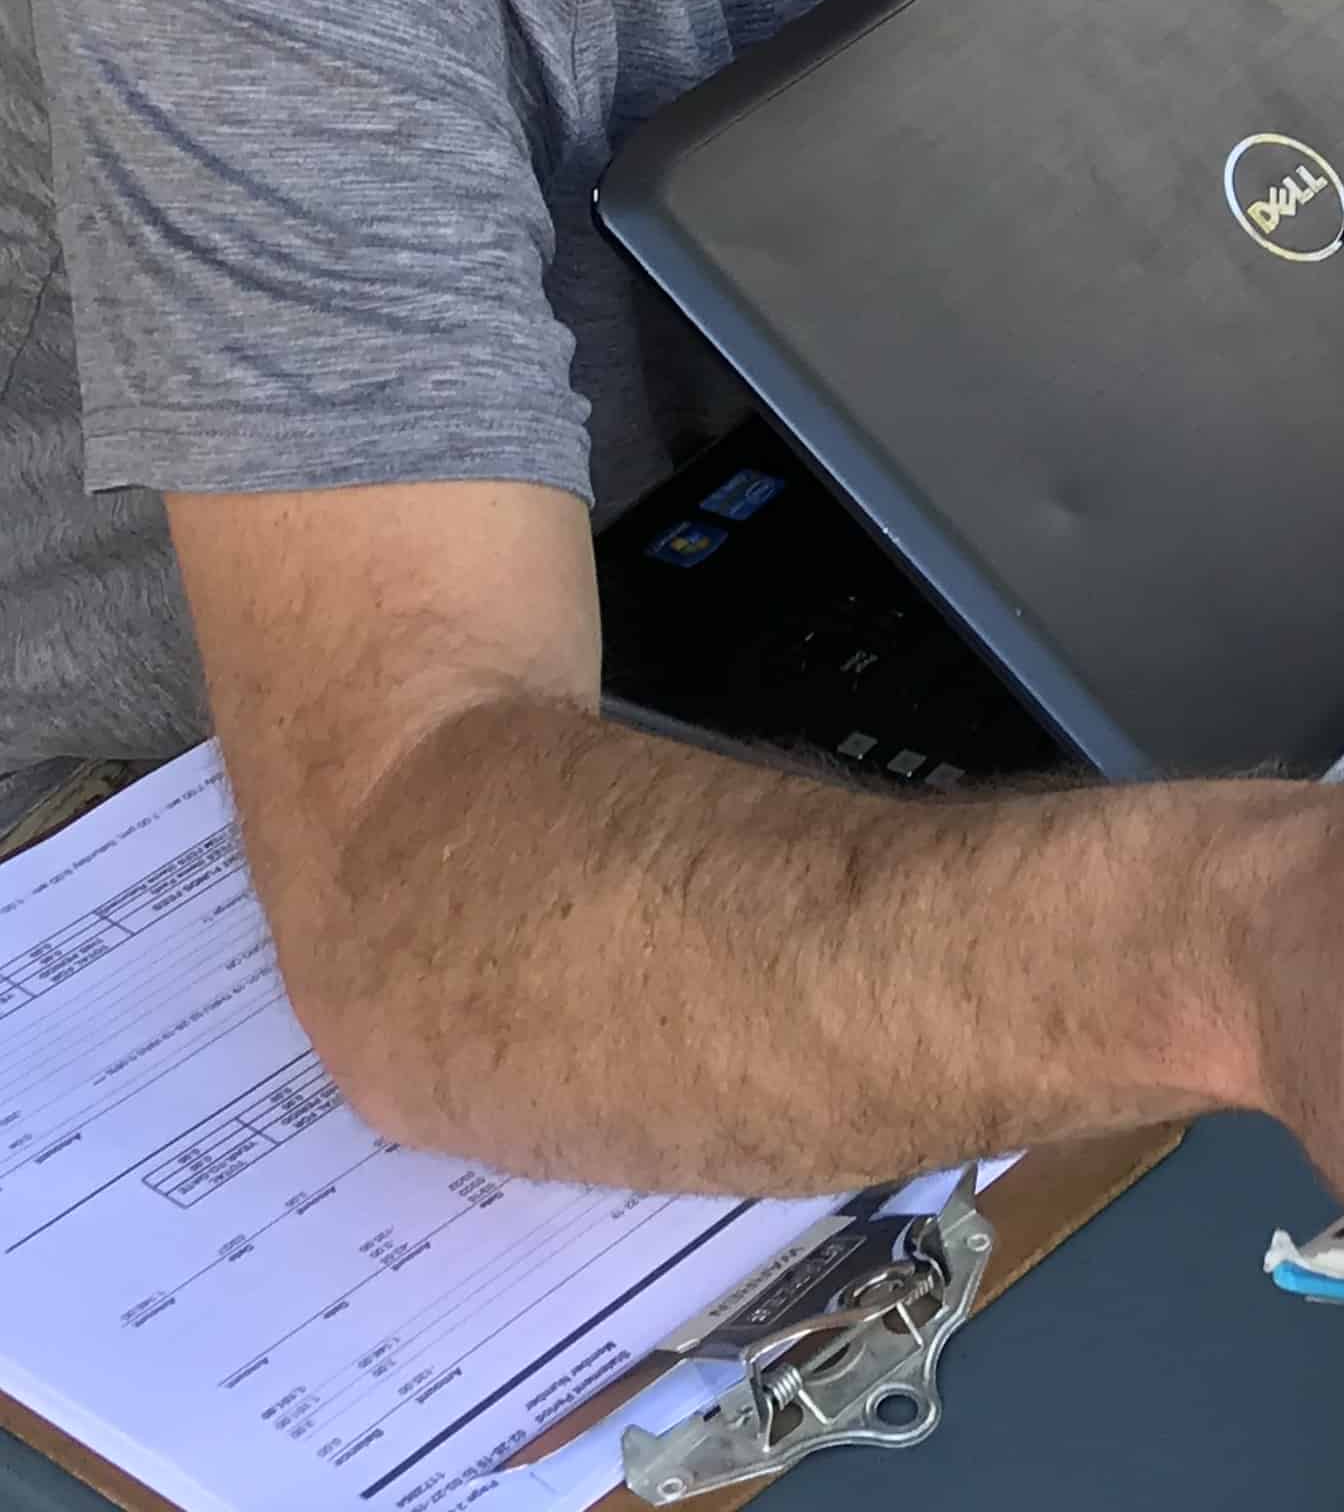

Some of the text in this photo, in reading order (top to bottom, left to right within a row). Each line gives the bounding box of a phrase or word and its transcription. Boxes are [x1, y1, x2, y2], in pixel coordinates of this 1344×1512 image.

[1246, 164, 1329, 235] DELL
[525, 1340, 617, 1411] Member Number
